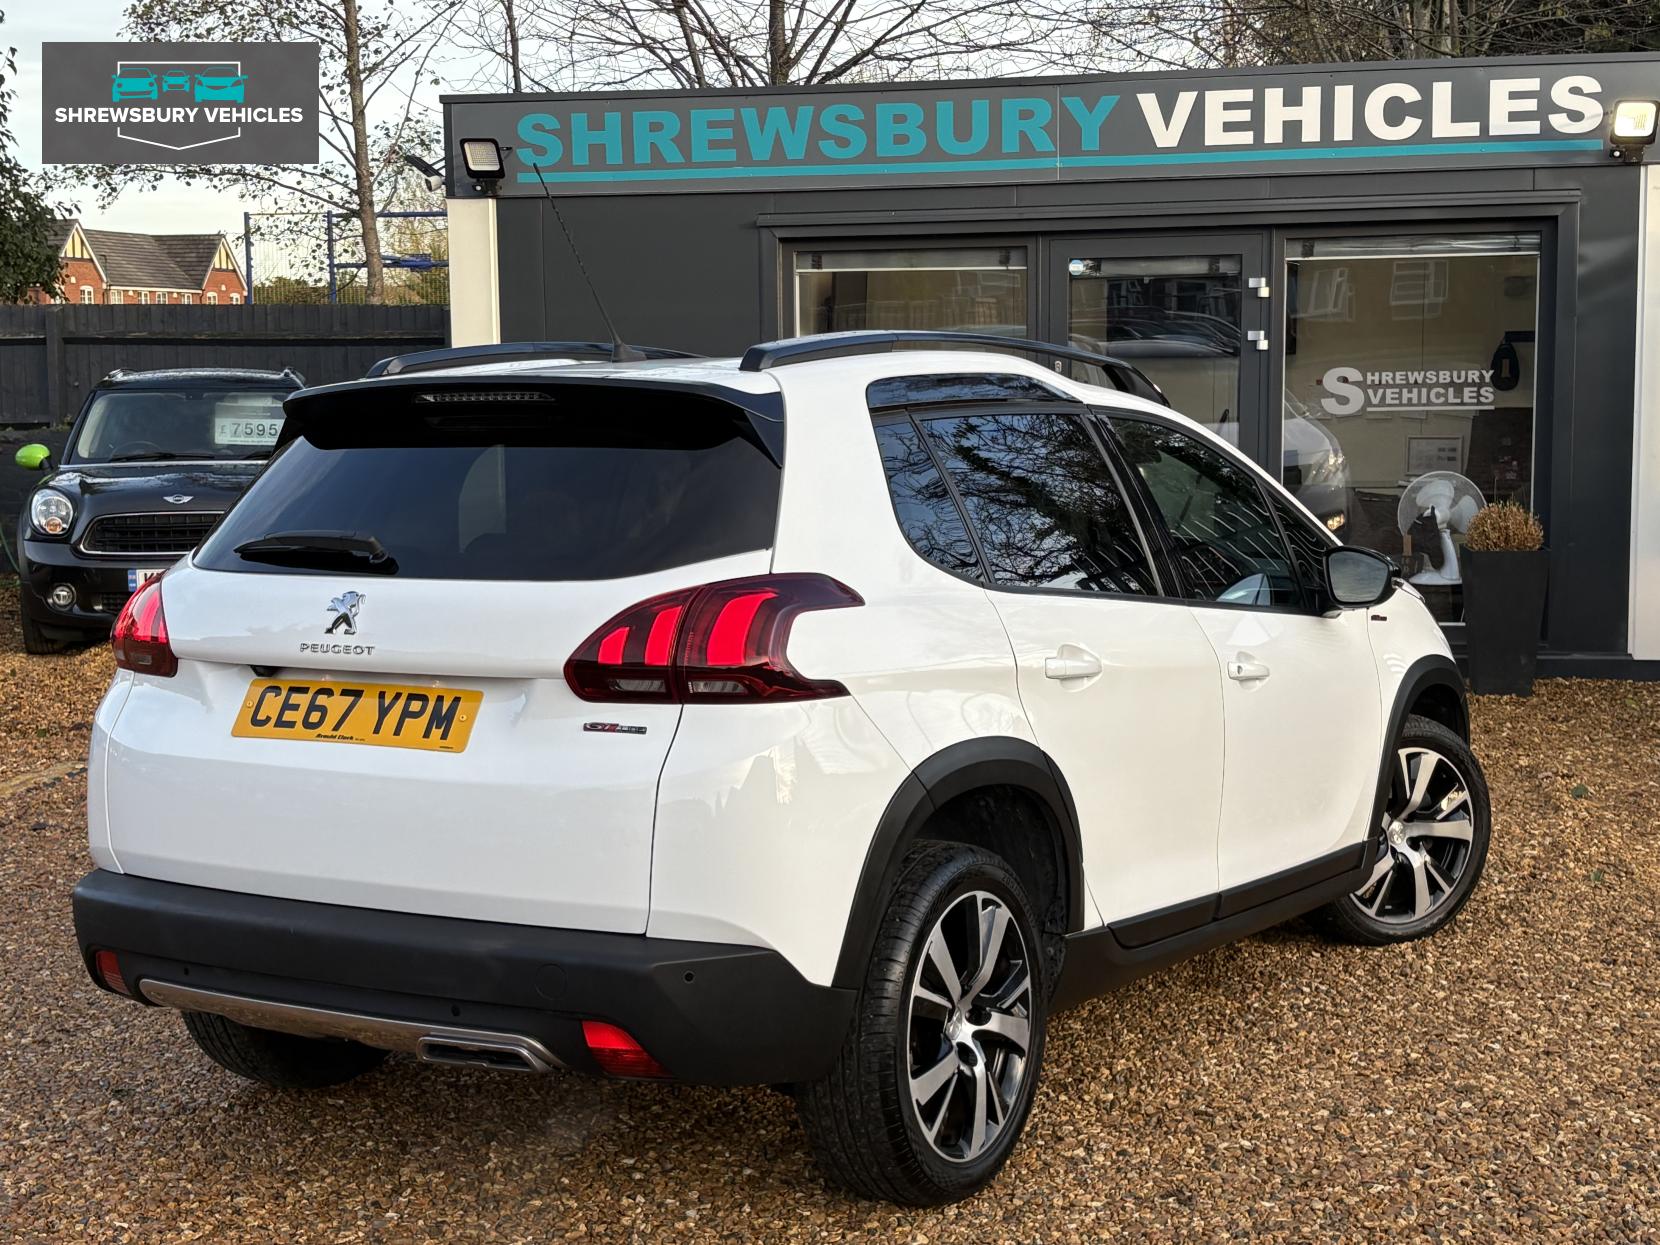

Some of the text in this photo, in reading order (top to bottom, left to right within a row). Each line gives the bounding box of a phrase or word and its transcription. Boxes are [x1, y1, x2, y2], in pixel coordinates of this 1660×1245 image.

[517, 75, 1604, 167] SHREWSBURY VEHICLES
[1366, 386, 1495, 405] VEHICLES
[299, 642, 375, 656] PEUGEOT
[250, 684, 463, 741] CE67 YPM
